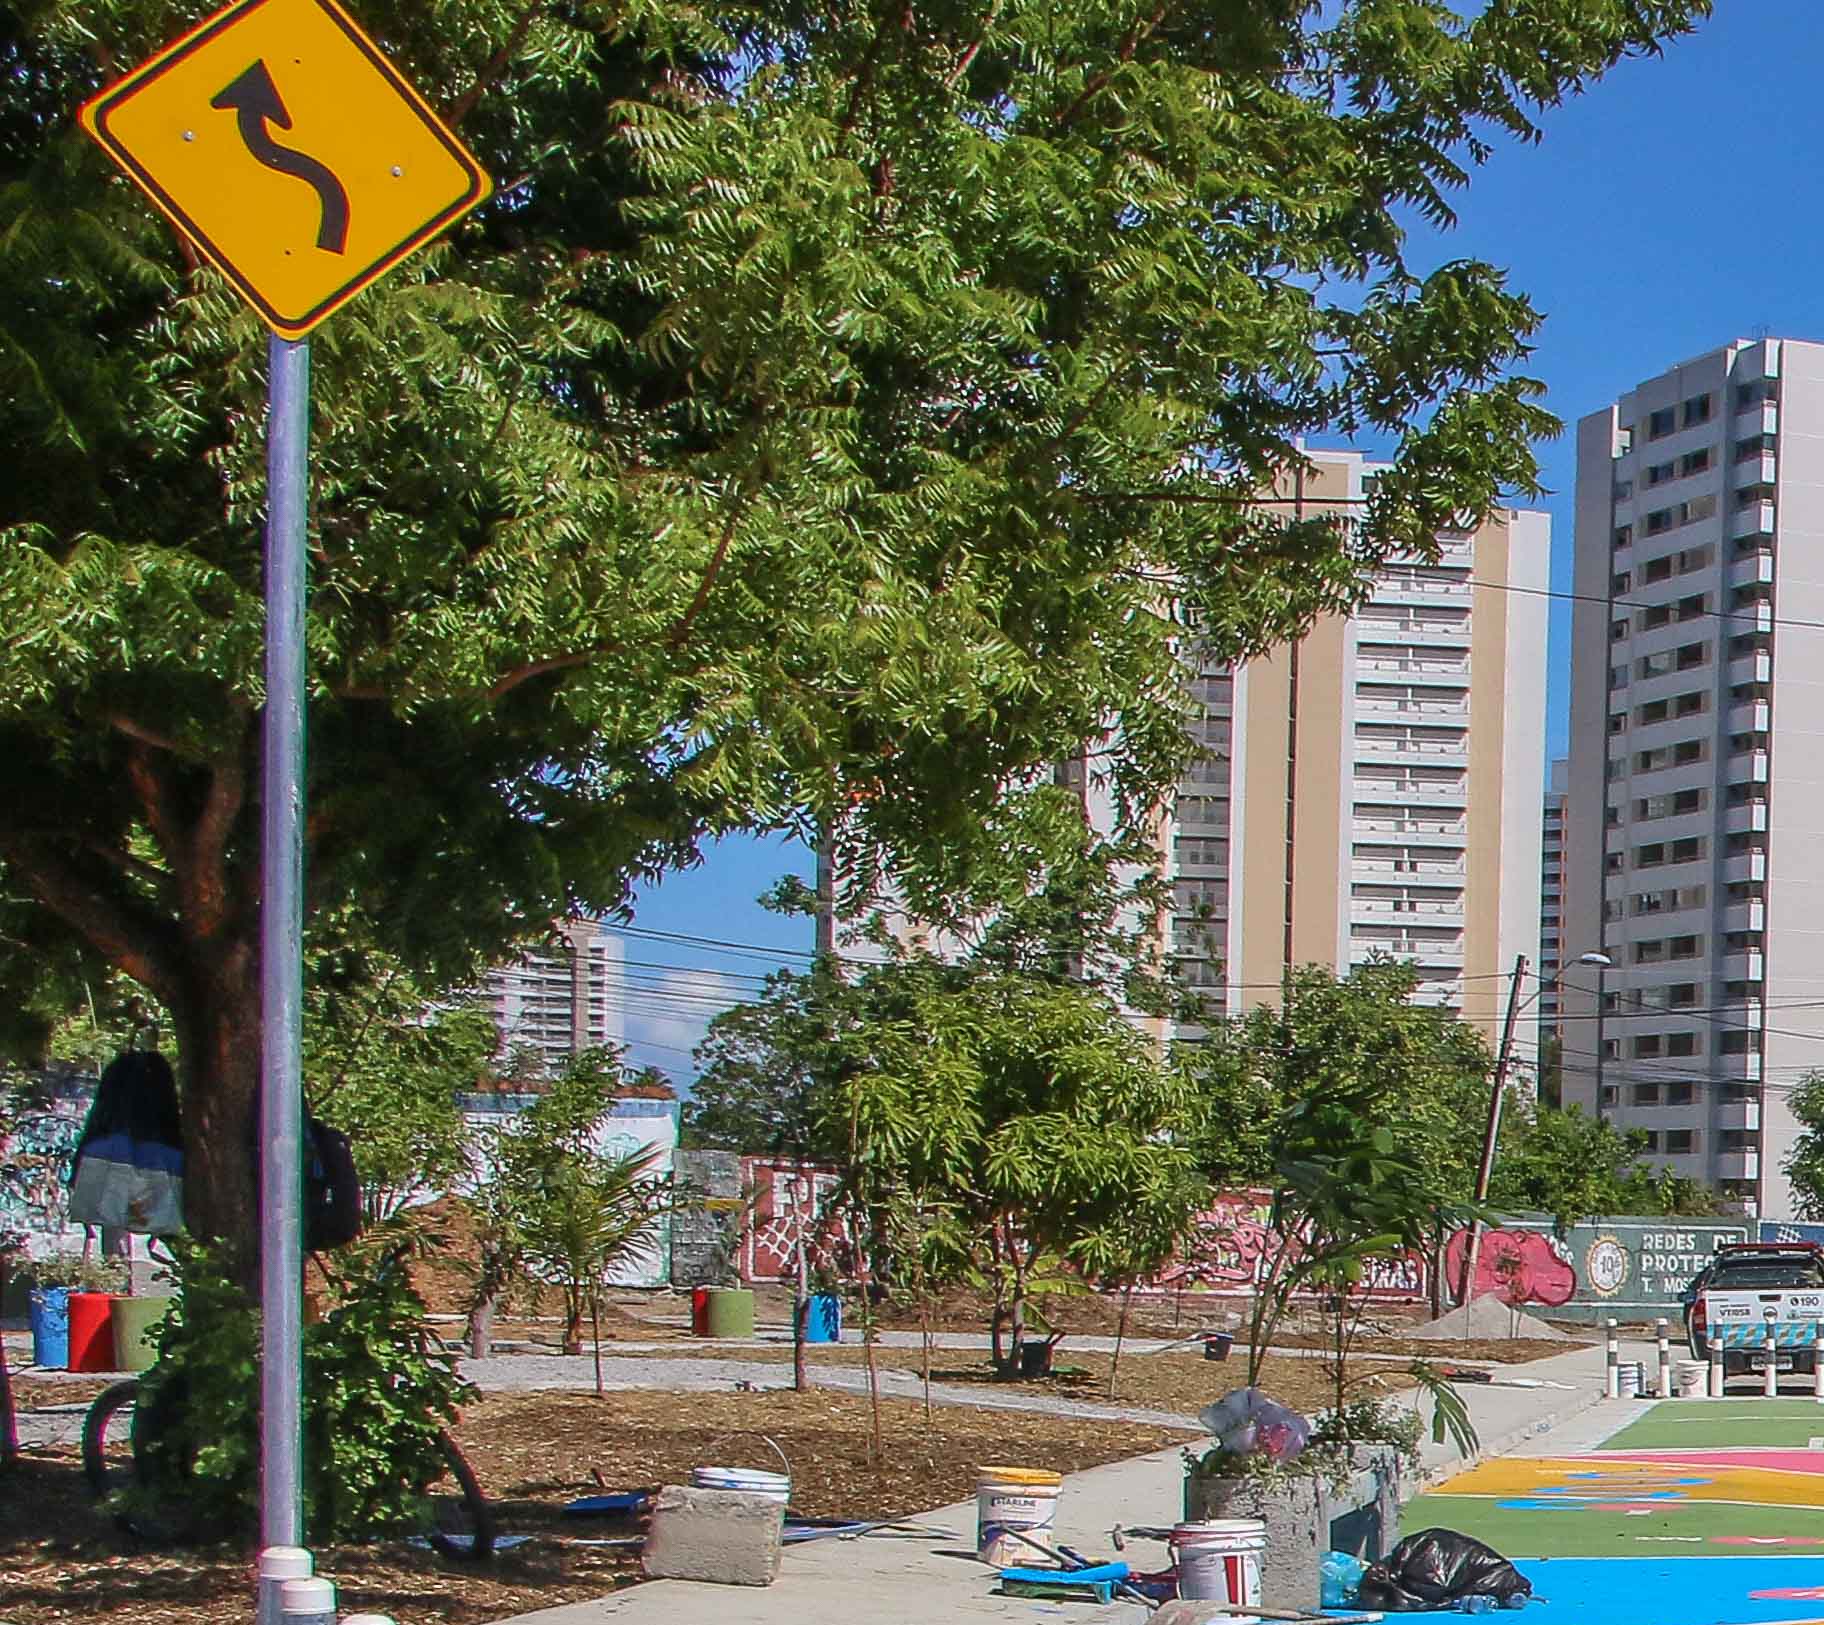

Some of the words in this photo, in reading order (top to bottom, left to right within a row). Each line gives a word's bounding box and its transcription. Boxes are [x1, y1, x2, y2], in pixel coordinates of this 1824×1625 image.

[1642, 1233, 1697, 1250] REDES
[1712, 1234, 1737, 1251] DE
[1641, 1277, 1653, 1294] T.
[1801, 1296, 1819, 1306] 190
